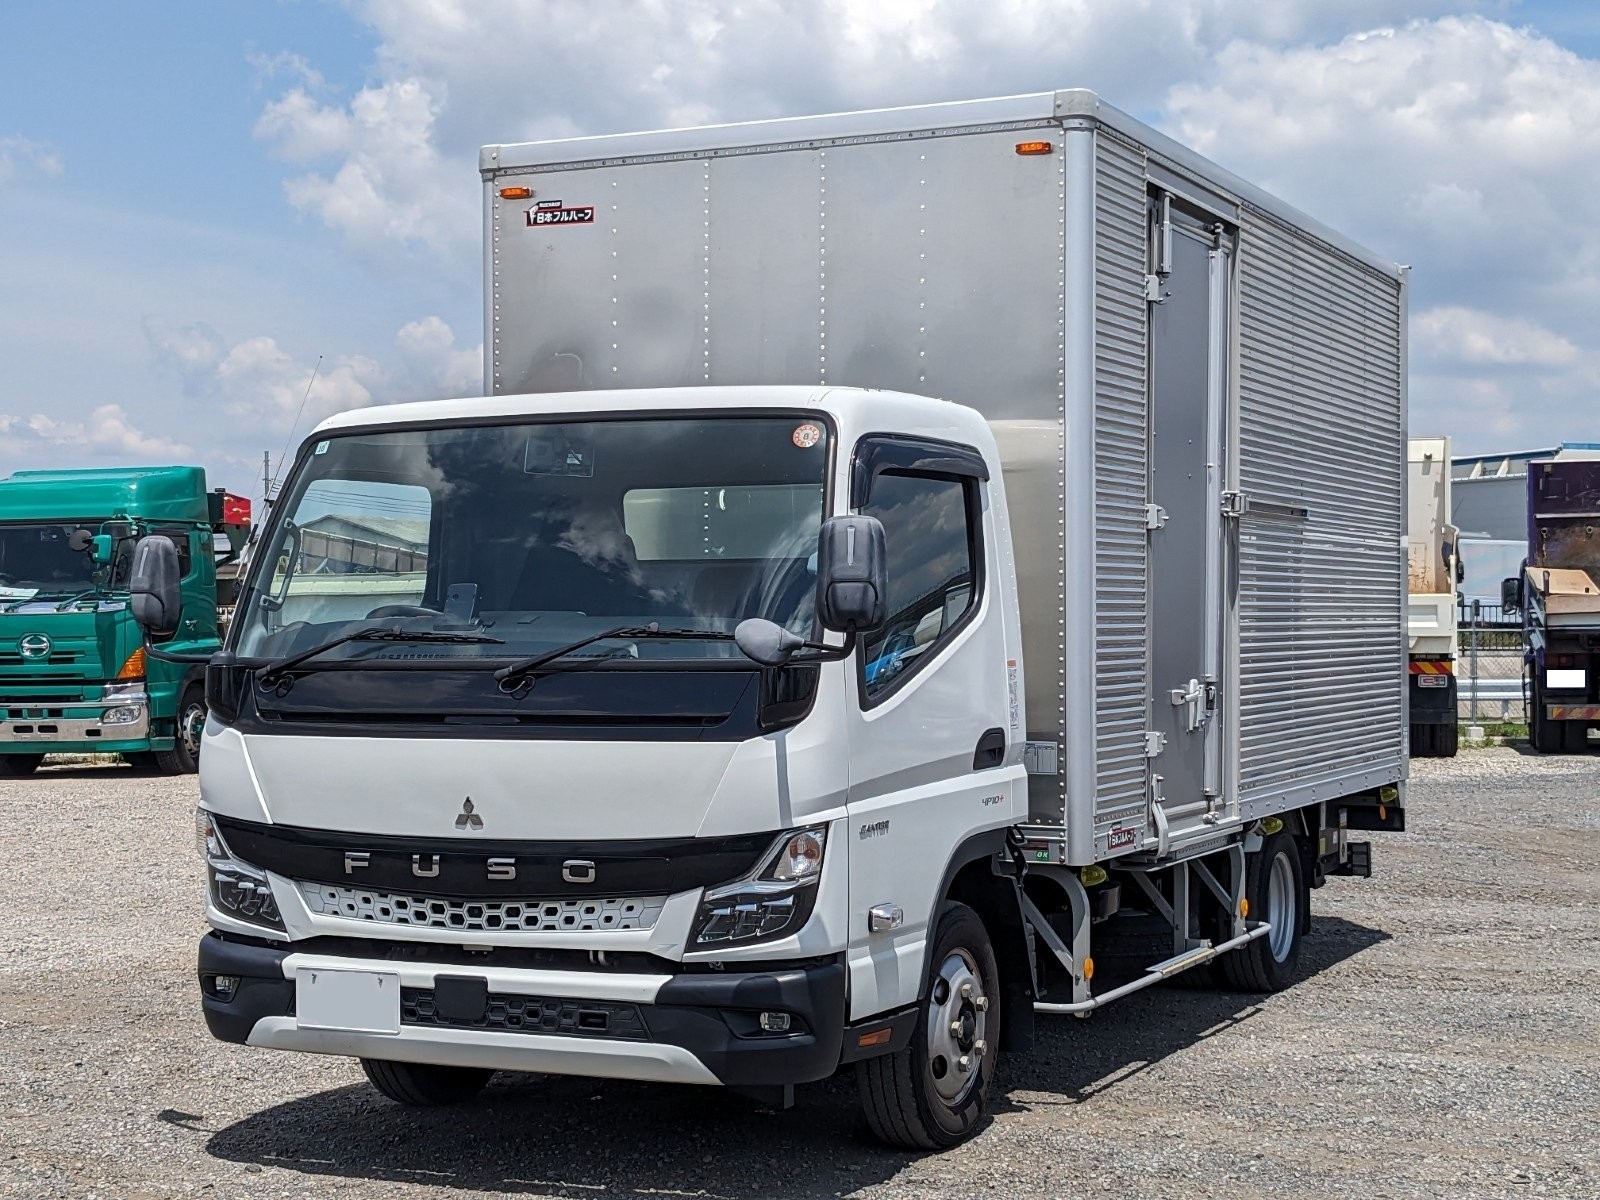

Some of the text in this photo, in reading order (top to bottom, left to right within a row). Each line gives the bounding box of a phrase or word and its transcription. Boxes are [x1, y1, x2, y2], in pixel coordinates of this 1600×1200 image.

[536, 209, 592, 224] 日本フルハーフ
[344, 851, 596, 883] FUSO
